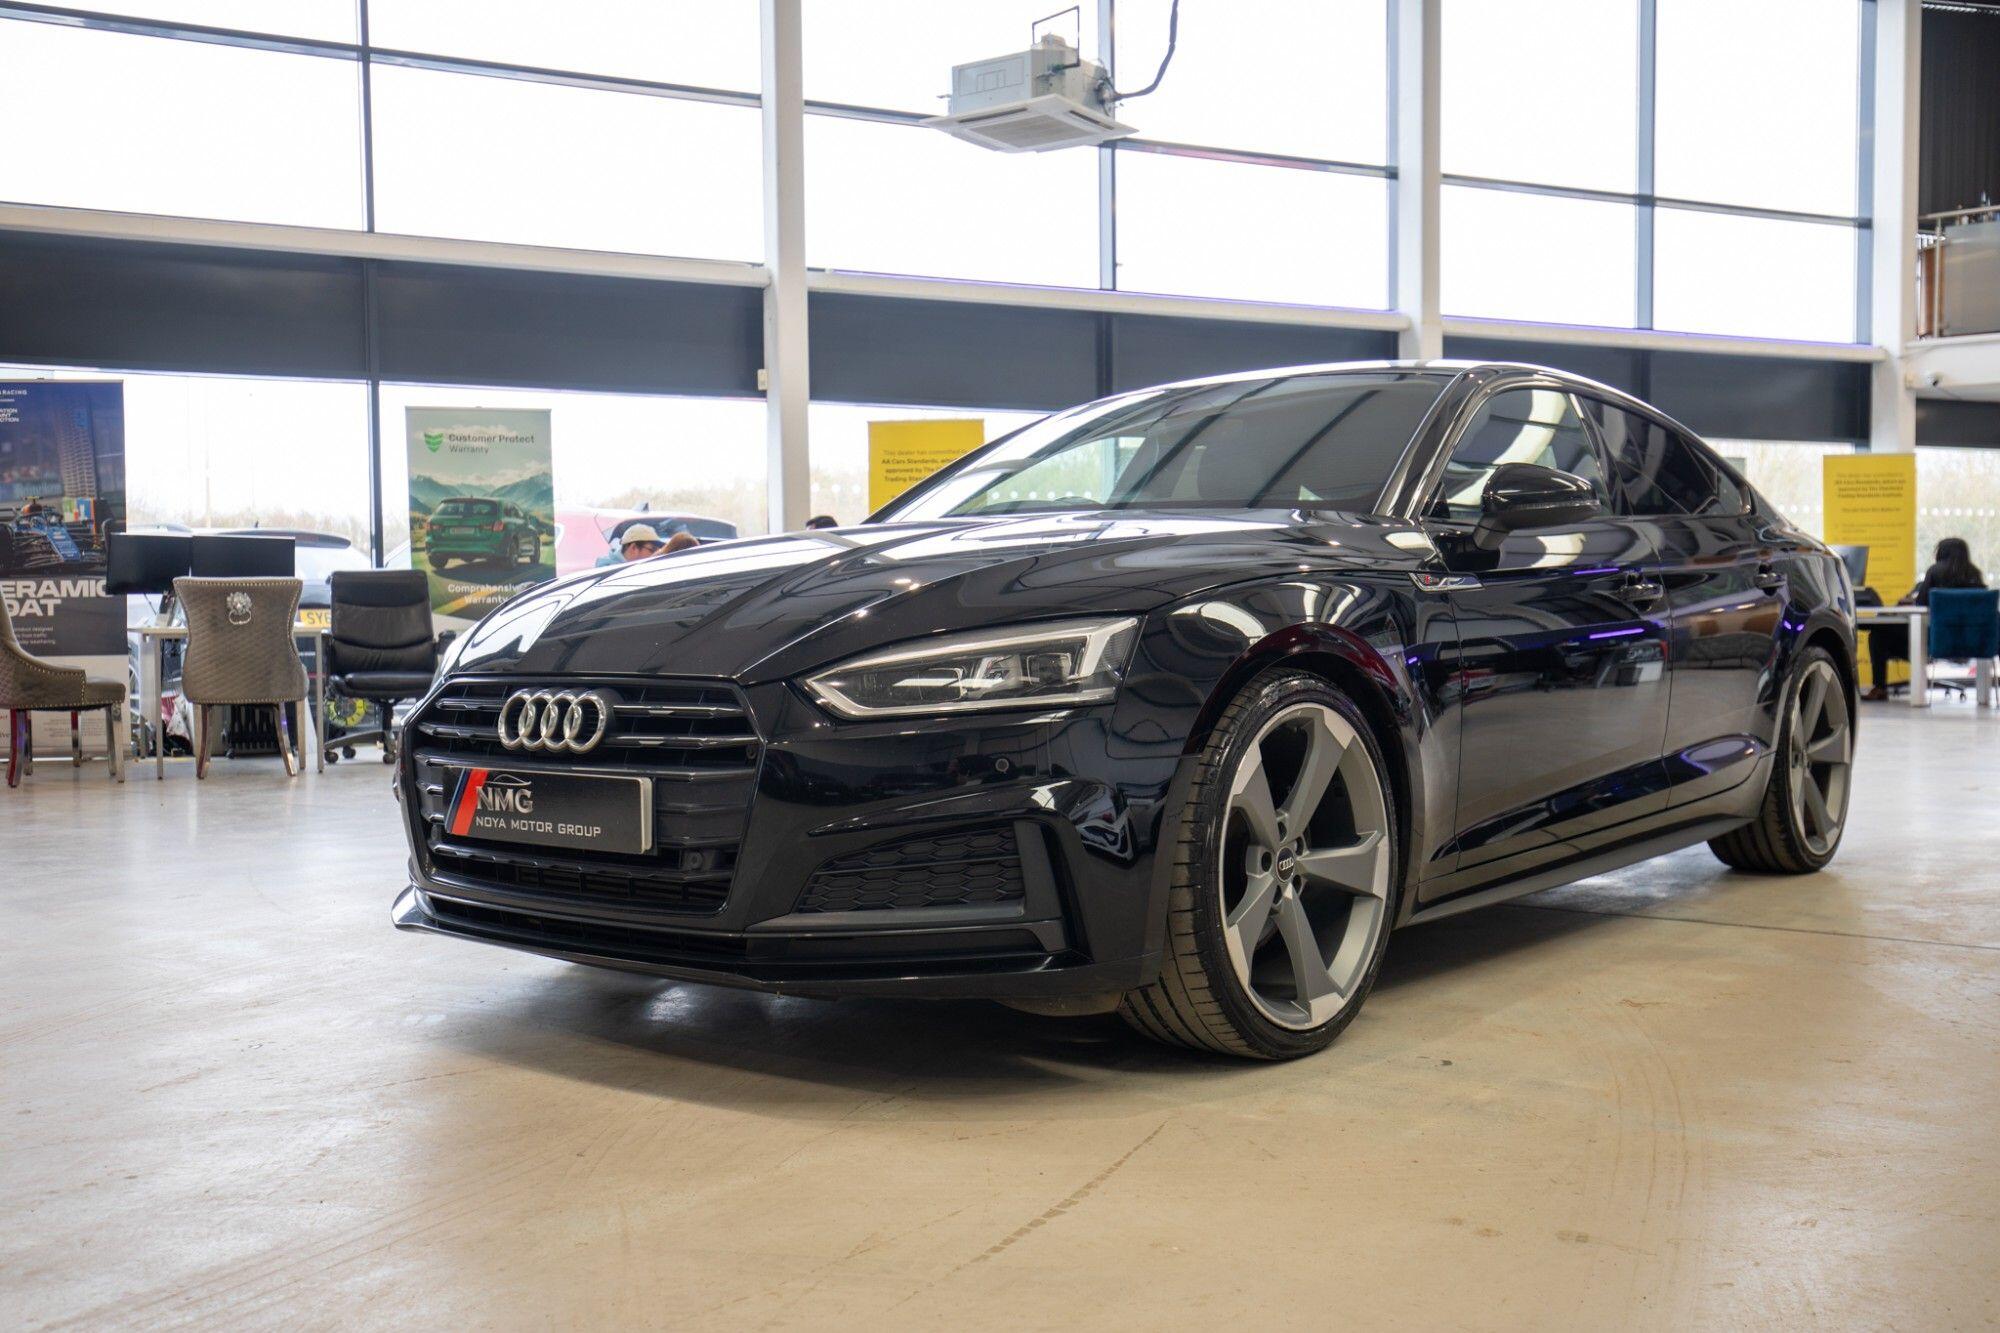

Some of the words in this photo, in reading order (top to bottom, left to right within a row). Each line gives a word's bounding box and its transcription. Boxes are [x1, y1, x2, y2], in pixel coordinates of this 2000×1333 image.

[448, 433, 497, 443] Customer
[498, 434, 535, 444] Protect
[449, 444, 489, 455] Warranty
[476, 785, 533, 813] NMG
[475, 816, 507, 829] NOYA
[511, 819, 553, 833] MOTOR
[557, 823, 601, 837] GROUP
